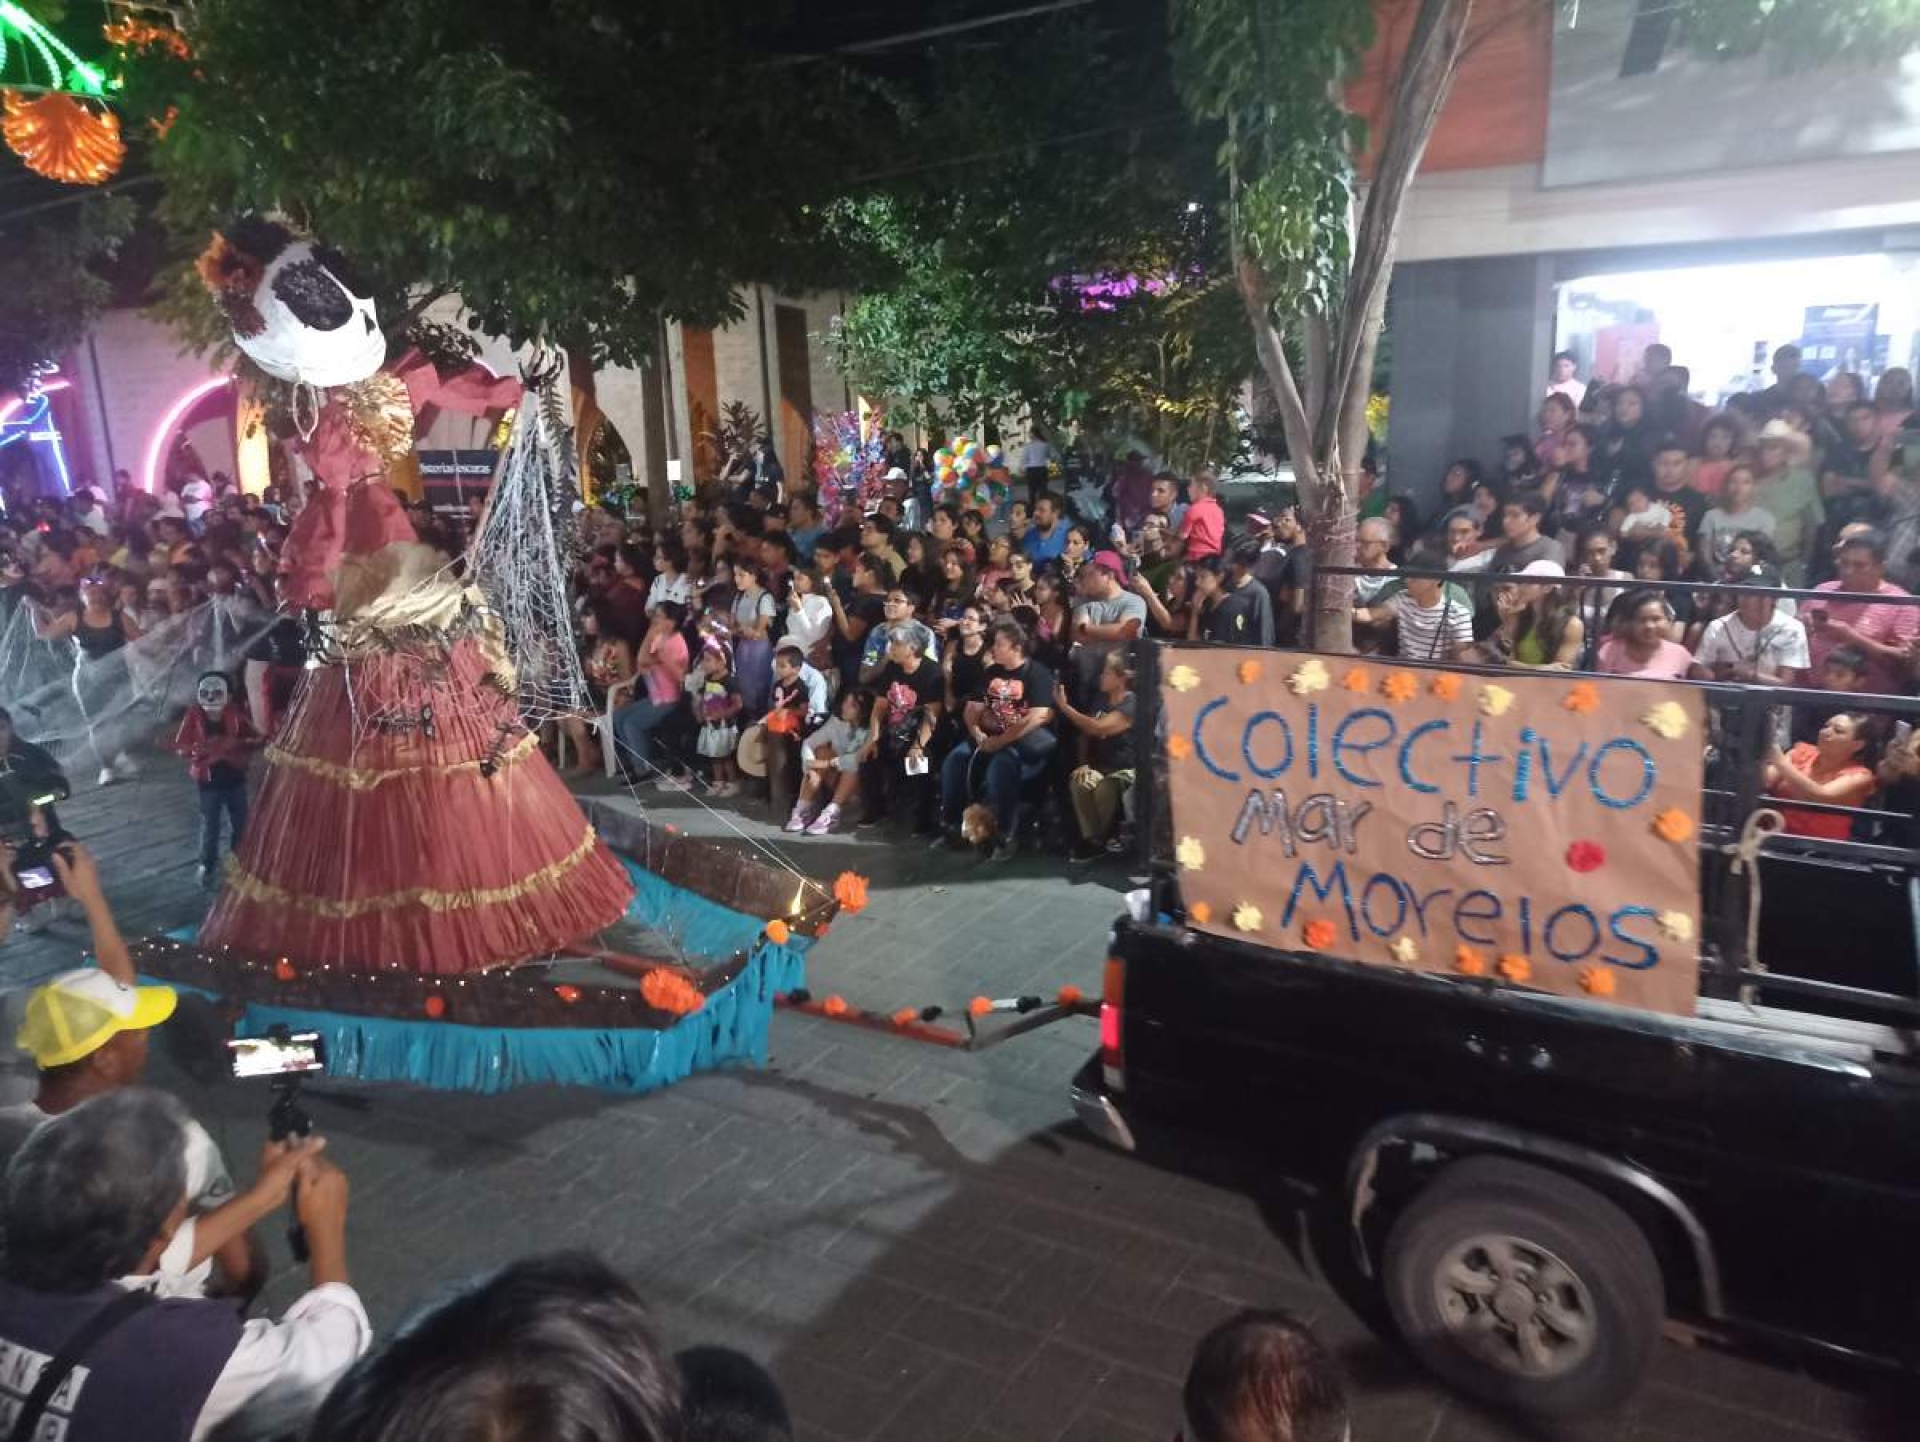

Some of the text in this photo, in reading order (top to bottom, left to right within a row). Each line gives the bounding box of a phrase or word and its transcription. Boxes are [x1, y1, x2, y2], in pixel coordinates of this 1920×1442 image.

[1230, 788, 1509, 865] Mar de
[1281, 859, 1662, 970] Morelos
